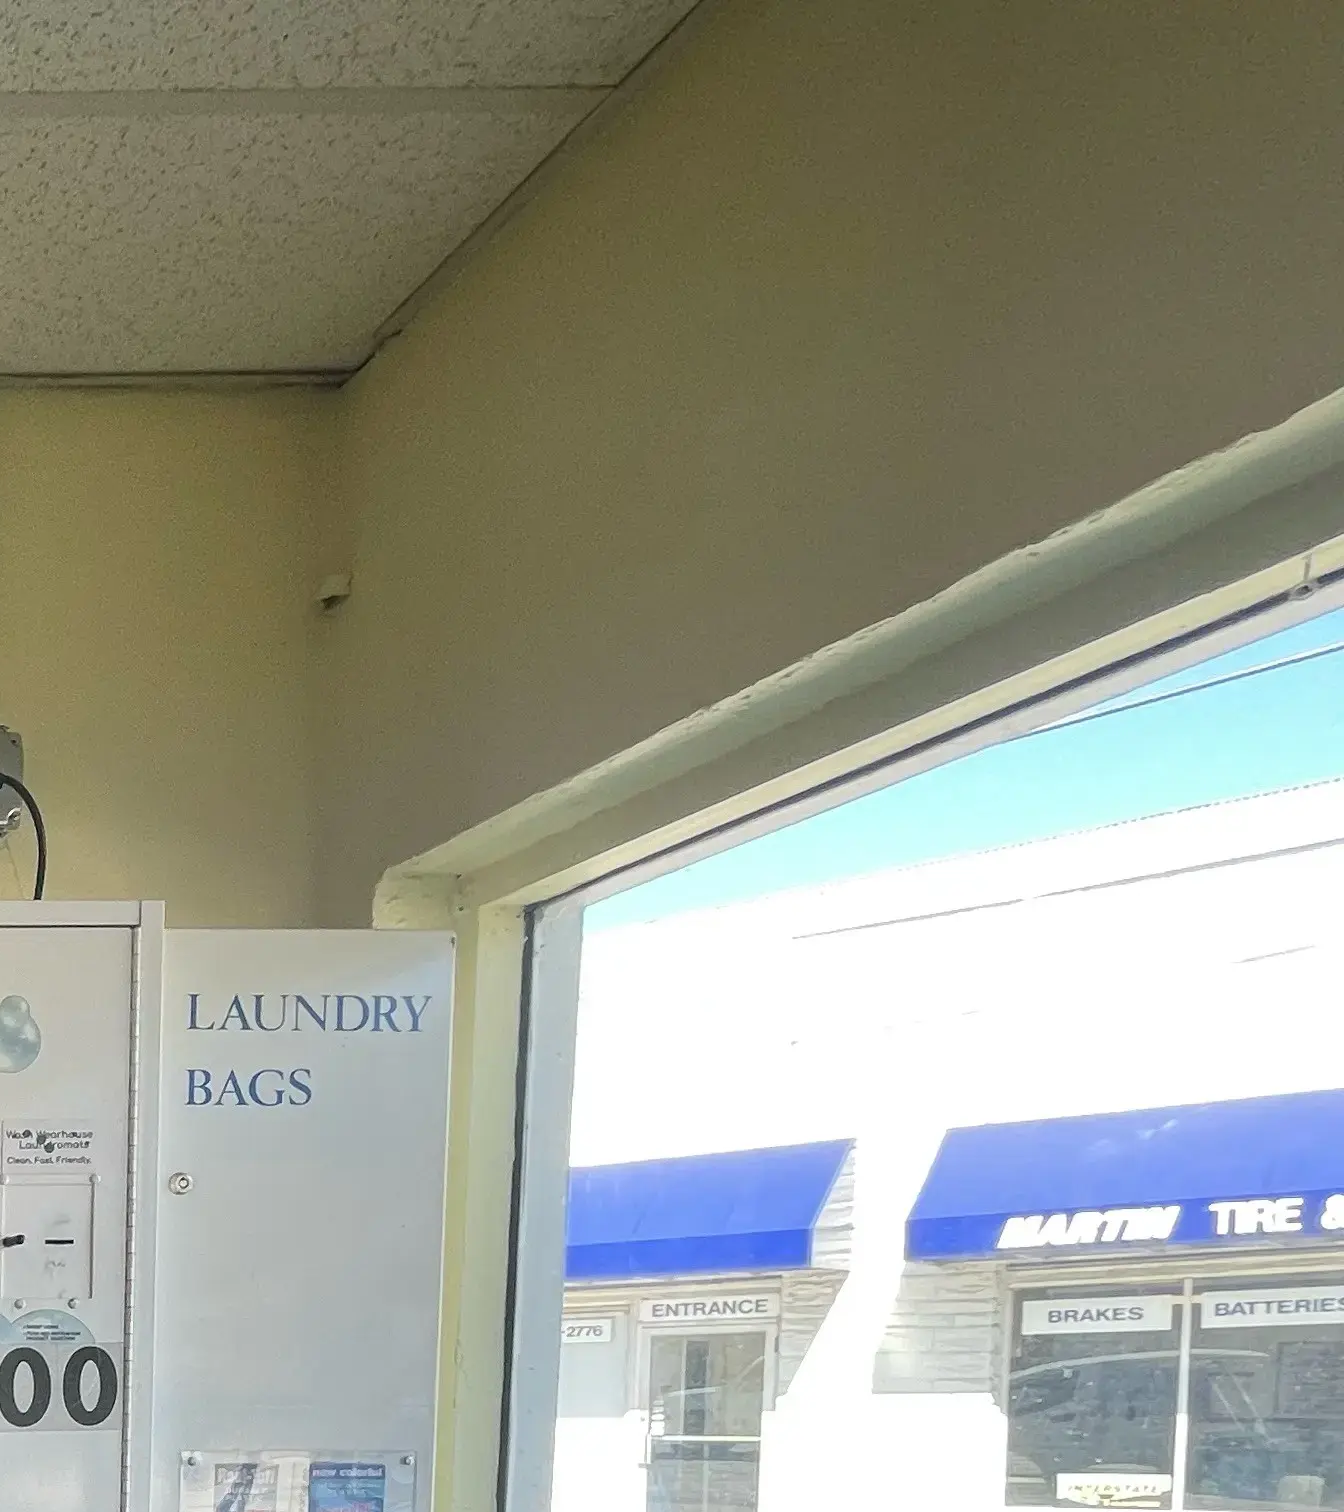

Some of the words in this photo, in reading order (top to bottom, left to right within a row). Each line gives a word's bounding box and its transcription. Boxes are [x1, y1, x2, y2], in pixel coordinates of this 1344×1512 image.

[186, 993, 433, 1033] LAUNDRY
[184, 1067, 313, 1107] BAGS
[996, 1206, 1181, 1249] MARTIN
[1208, 1197, 1305, 1235] TIRE
[651, 1298, 769, 1318] ENTRANCE
[1047, 1306, 1145, 1324] BRAKES
